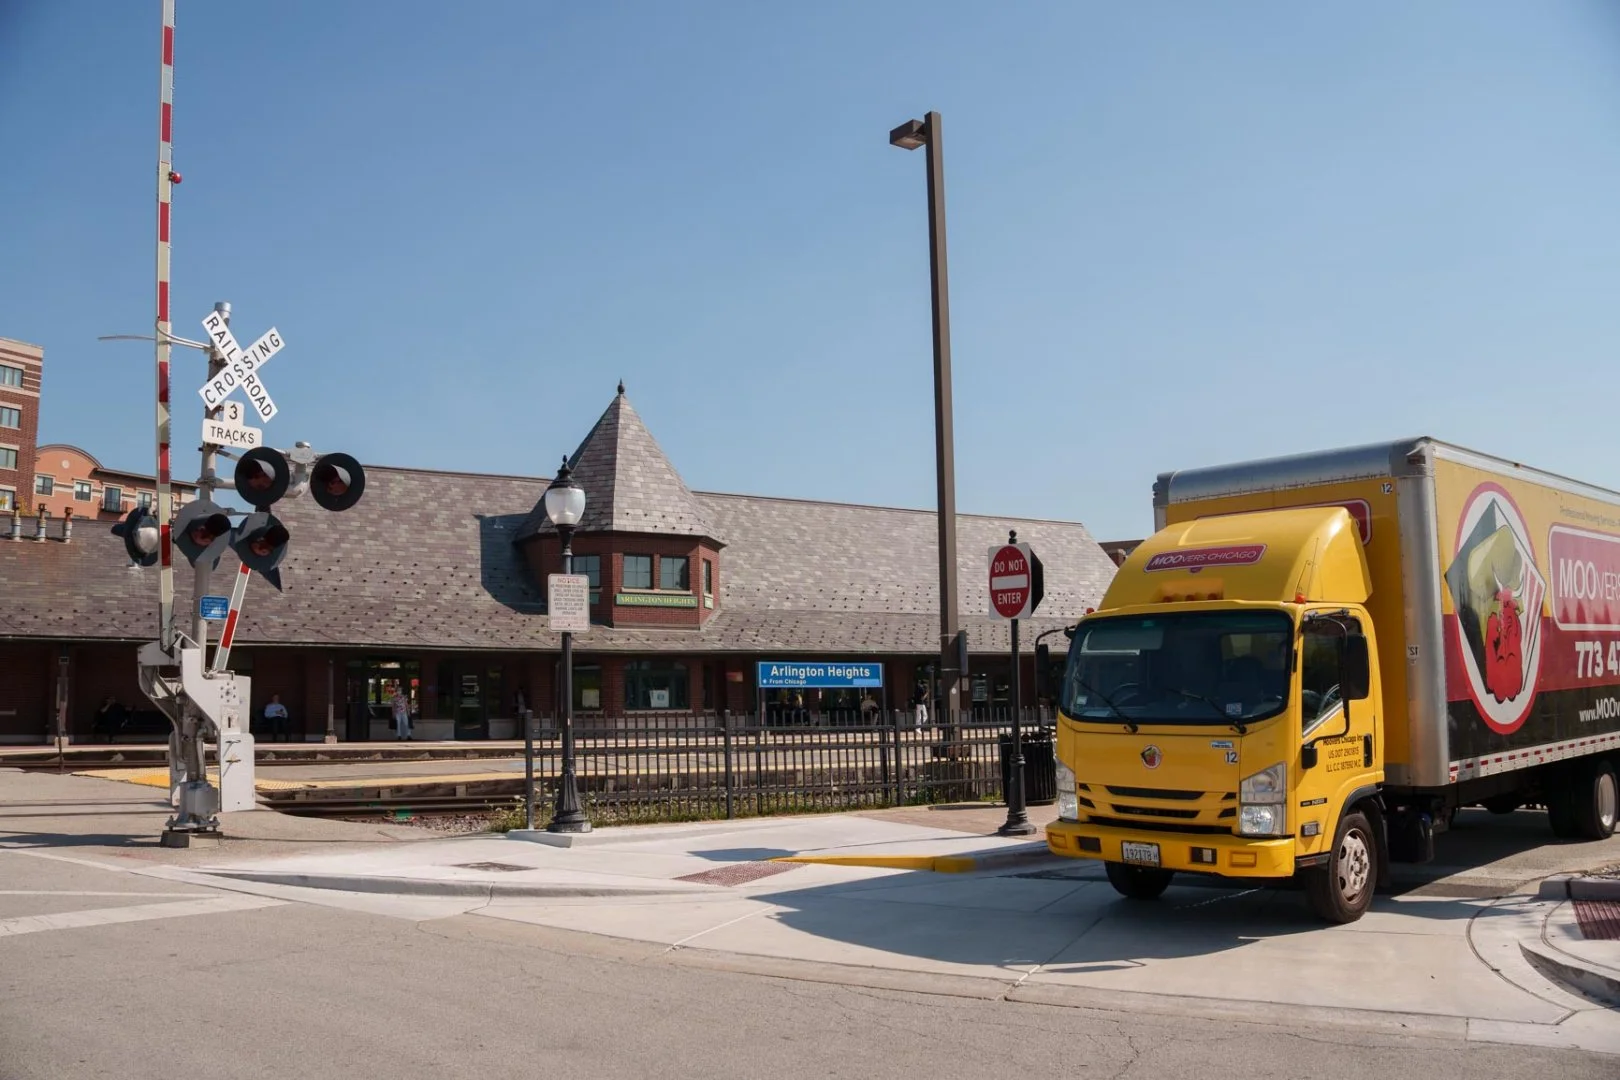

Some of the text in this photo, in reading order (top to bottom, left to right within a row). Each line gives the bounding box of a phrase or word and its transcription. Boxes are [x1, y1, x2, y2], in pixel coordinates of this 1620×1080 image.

[204, 333, 280, 404] CROSSING
[229, 404, 238, 420] 3
[210, 425, 255, 444] TRACKS
[1382, 483, 1393, 493] 12
[1151, 550, 1257, 566] MOOVERS CHICAGO
[994, 559, 1024, 573] DO NOT
[620, 596, 695, 605] ARLINGTON HEIGHTS
[997, 592, 1022, 605] ENTER
[1575, 641, 1604, 679] 773
[771, 666, 871, 679] Arlington Heights
[1226, 751, 1238, 763] 12
